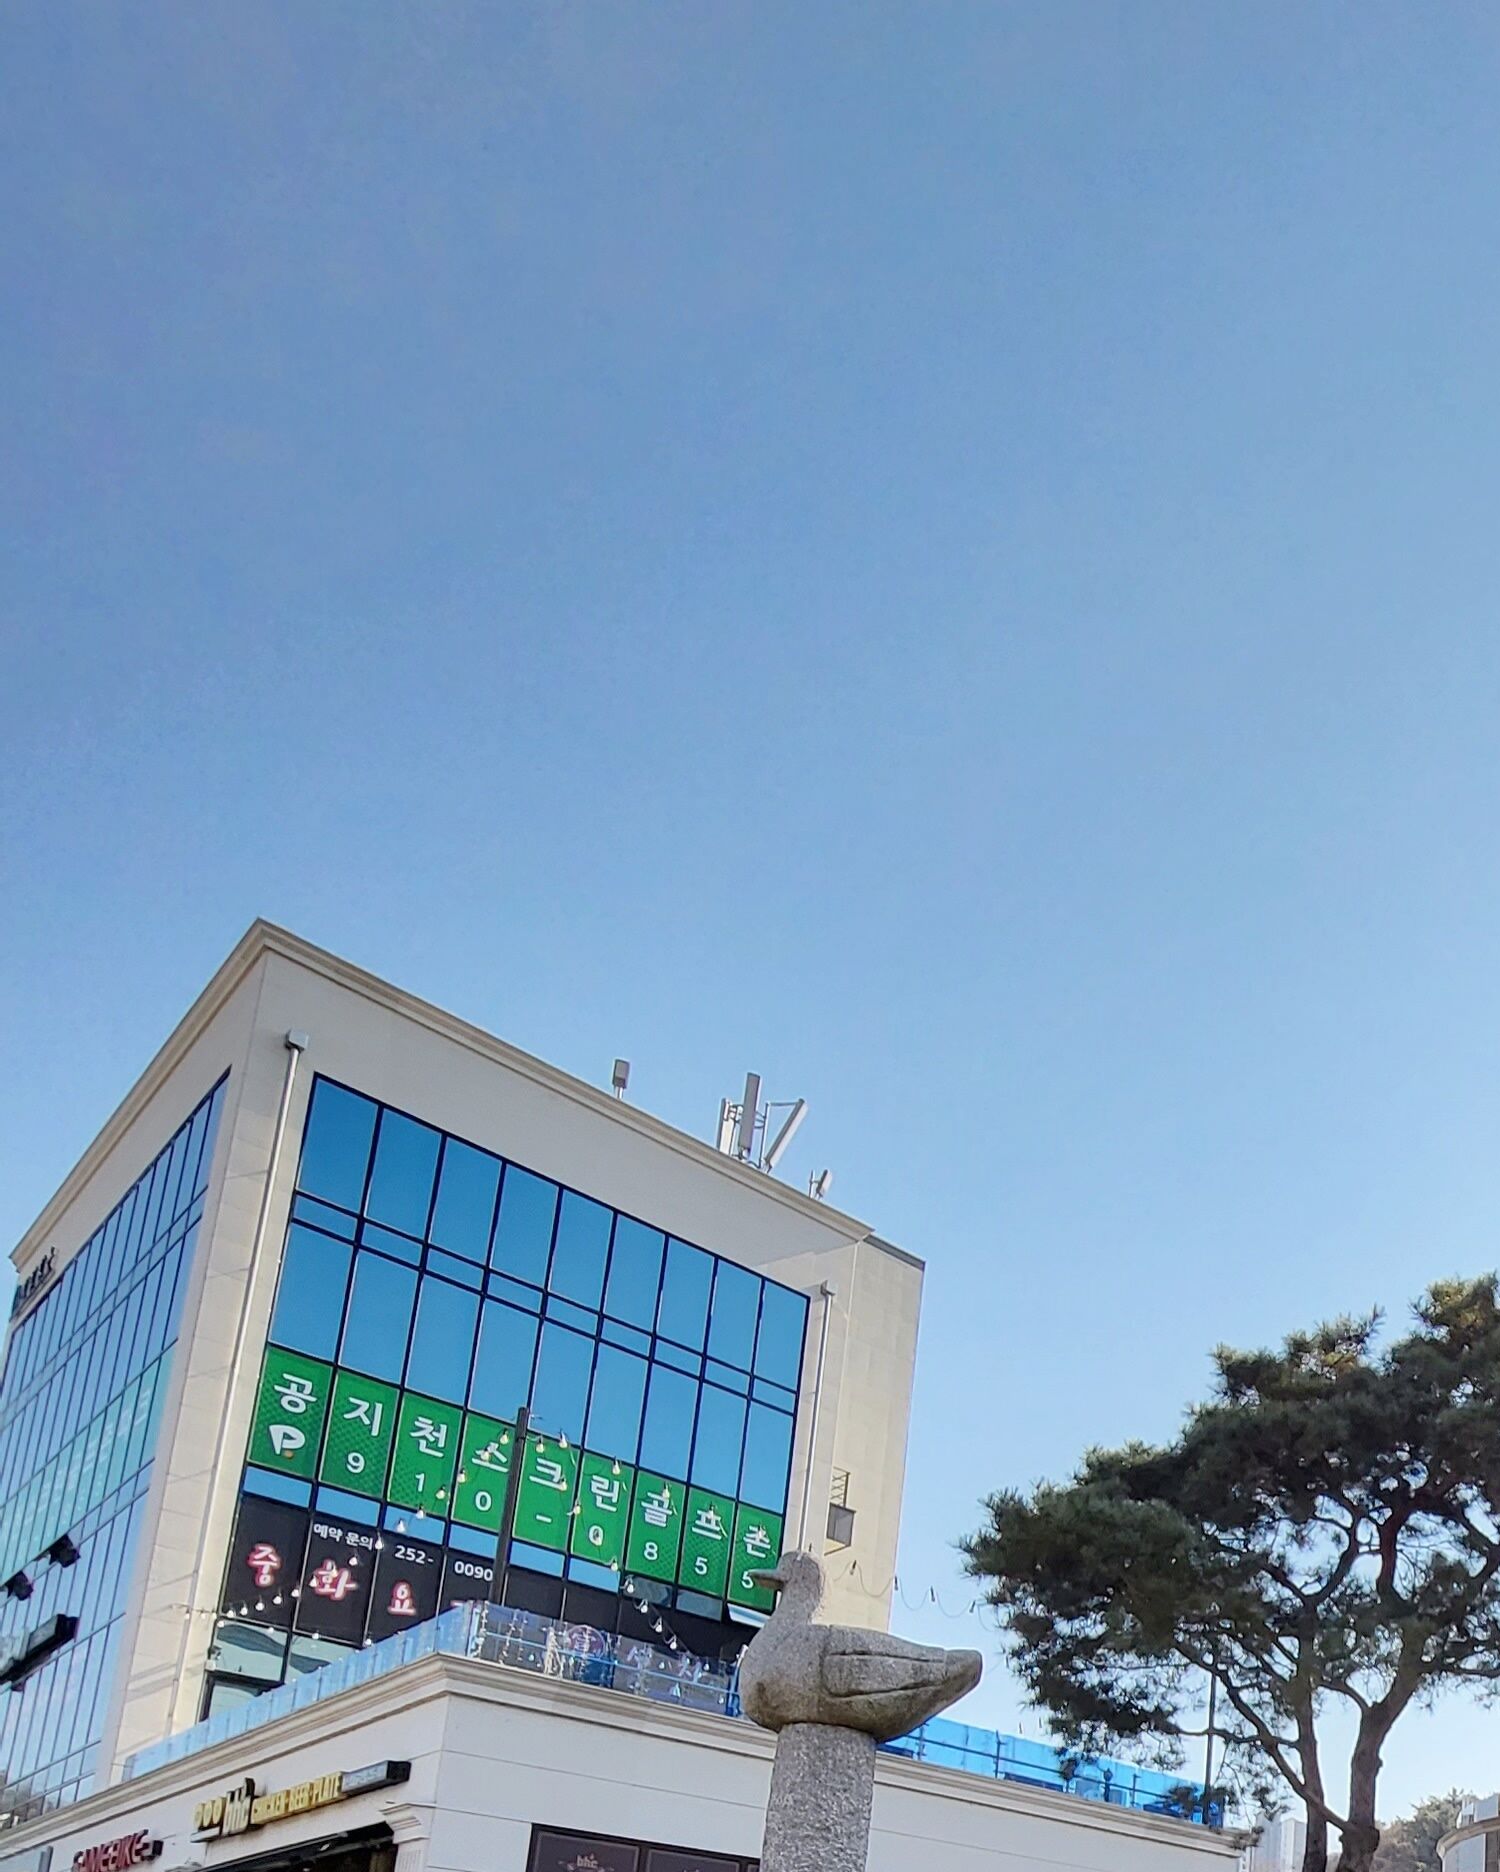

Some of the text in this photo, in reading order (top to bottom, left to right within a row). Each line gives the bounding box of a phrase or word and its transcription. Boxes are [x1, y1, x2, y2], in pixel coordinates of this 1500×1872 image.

[313, 1523, 343, 1542] 예약
[346, 1531, 374, 1550] 문의
[576, 1854, 598, 1869] bhc
